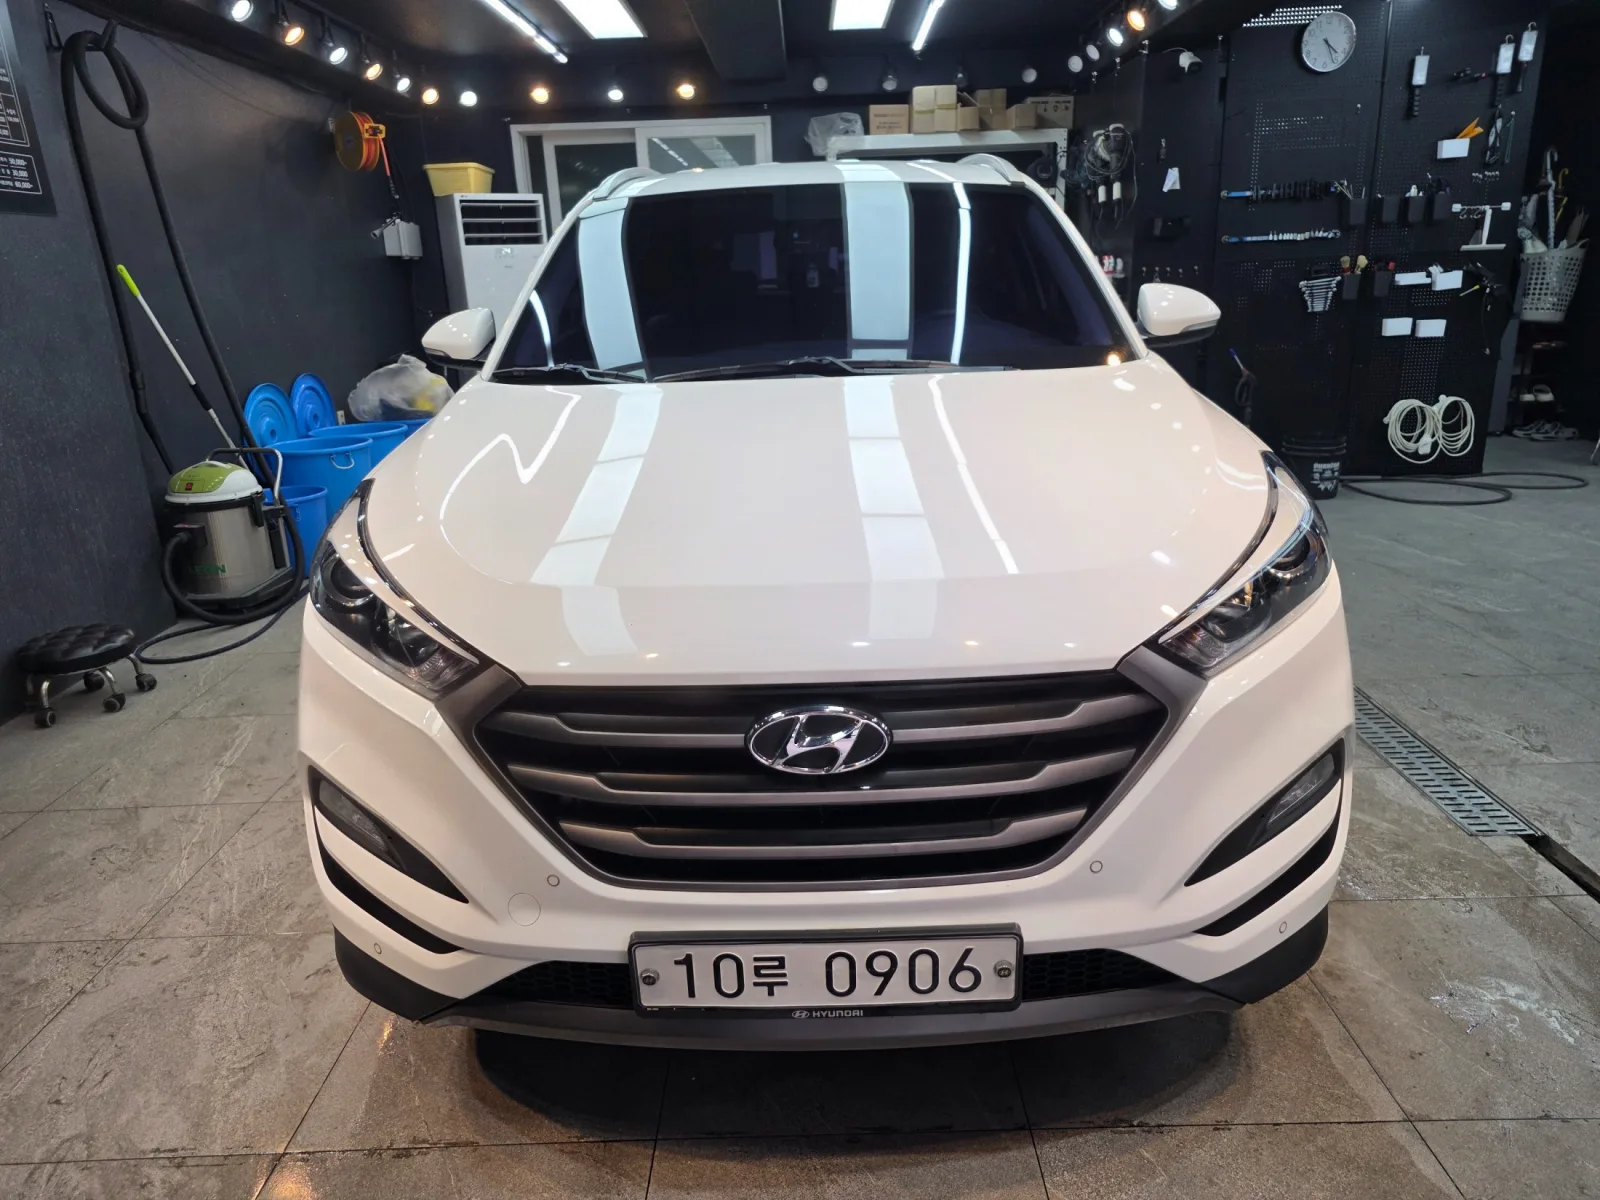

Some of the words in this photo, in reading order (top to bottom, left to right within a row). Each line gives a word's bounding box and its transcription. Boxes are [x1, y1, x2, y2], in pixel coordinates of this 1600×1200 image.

[674, 953, 788, 998] 10루
[825, 948, 982, 997] 0906
[812, 1010, 864, 1018] HYUNDAI
